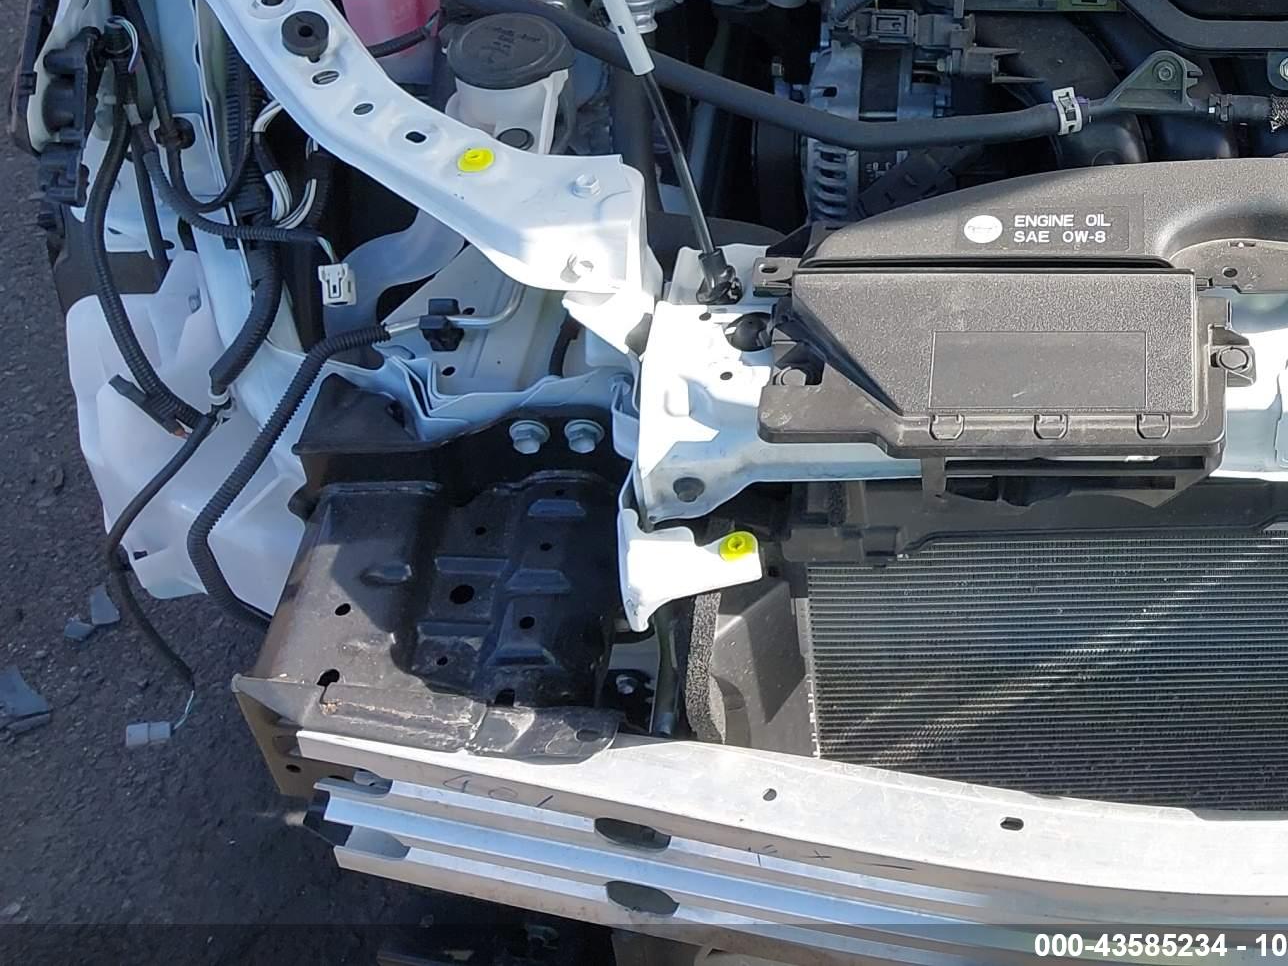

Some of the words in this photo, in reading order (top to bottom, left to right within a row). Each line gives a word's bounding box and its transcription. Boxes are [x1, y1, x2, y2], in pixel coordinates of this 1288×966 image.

[1014, 214, 1075, 227] ENGINE
[1085, 214, 1112, 227] OIL
[1013, 230, 1050, 243] SAE
[1062, 230, 1106, 243] 0W-8
